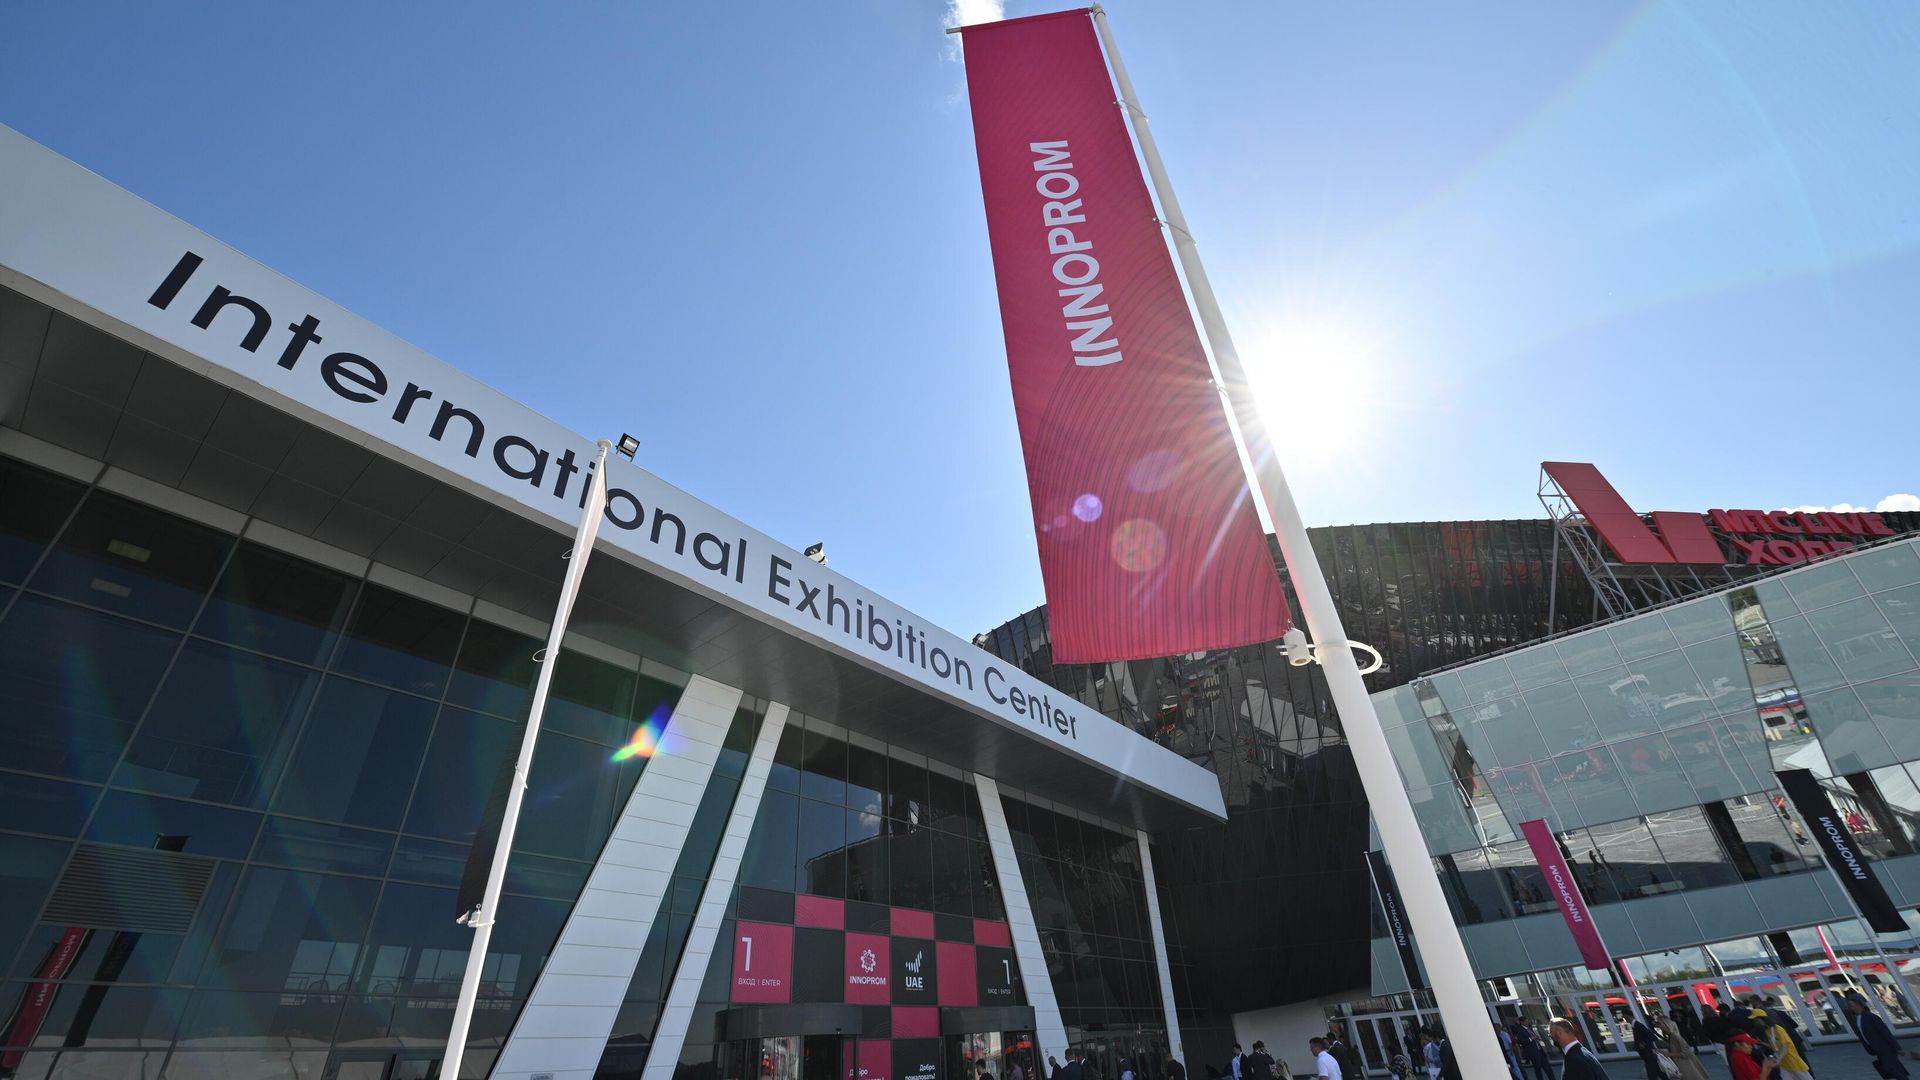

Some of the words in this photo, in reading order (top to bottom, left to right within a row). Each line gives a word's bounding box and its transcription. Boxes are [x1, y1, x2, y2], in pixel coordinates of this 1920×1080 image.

[1029, 140, 1123, 366] INNOPROM
[148, 251, 747, 584] International
[768, 555, 973, 691] Exhibition
[984, 666, 1078, 741] Center
[1796, 512, 1896, 536] LIVE
[1818, 816, 1867, 880] INNOPROM
[1549, 864, 1583, 922] INNOPROM
[1386, 892, 1407, 946] INNOPROM
[741, 936, 752, 972] 1
[738, 977, 756, 986] ВХОД
[761, 978, 781, 987] ENTER
[849, 975, 886, 985] INNOPROM
[905, 976, 923, 988] UAE
[1002, 959, 1011, 985] 1
[919, 1063, 936, 1072] Добро
